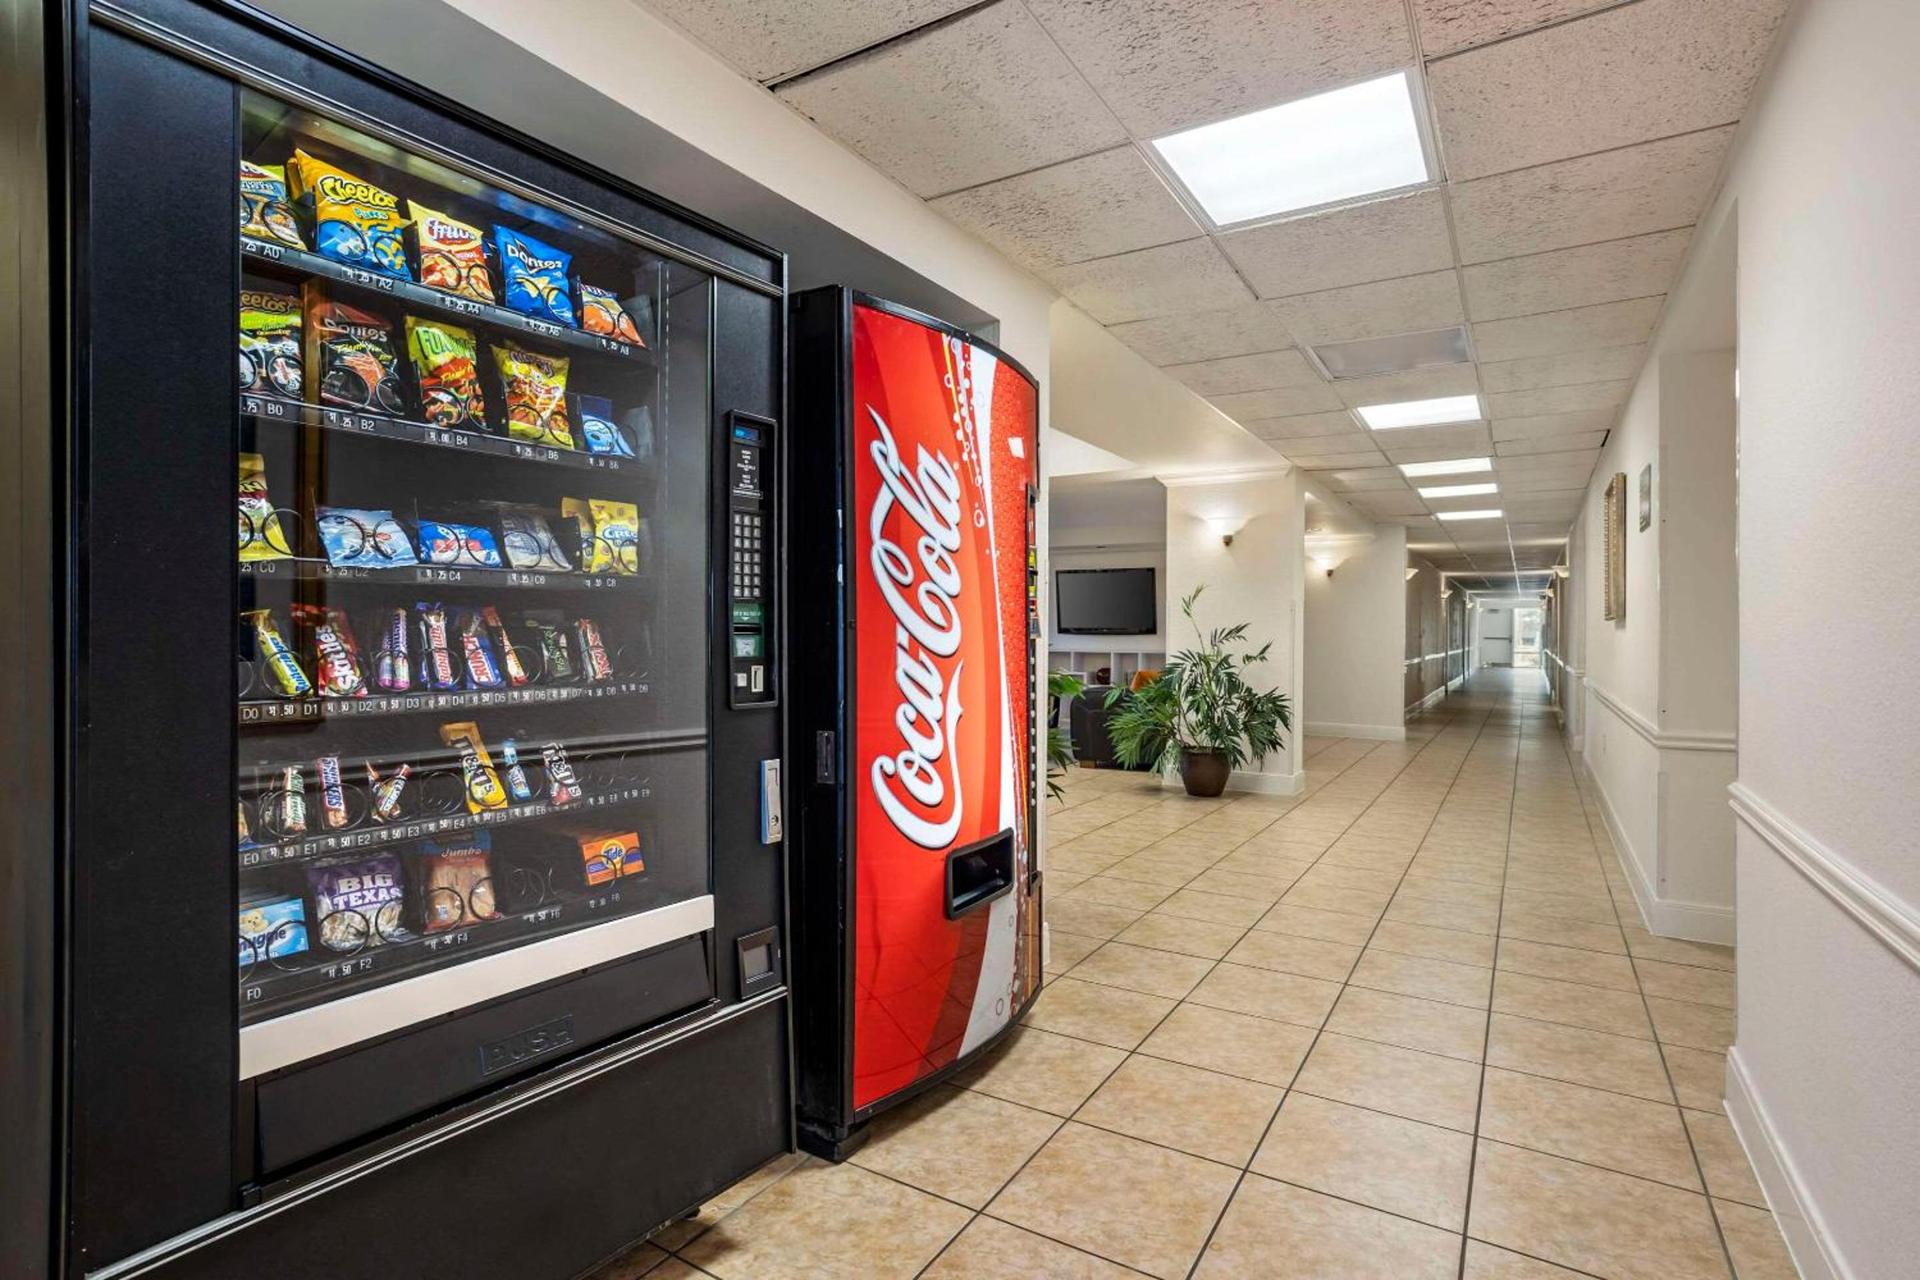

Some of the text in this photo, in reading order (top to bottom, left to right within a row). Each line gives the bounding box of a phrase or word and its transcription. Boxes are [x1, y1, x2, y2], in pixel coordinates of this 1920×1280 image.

[319, 176, 399, 208] Cheetos
[507, 245, 563, 271] Doritos
[240, 292, 288, 312] eetos
[267, 403, 283, 415] B0
[361, 419, 374, 431] B2
[449, 570, 461, 581] C4
[866, 404, 963, 849] Coca-Cola
[316, 625, 358, 690] Skittles
[242, 707, 259, 720] D0
[304, 703, 318, 715] D1
[359, 701, 373, 712] D2
[406, 698, 420, 709] D3
[452, 696, 464, 706] D4
[243, 854, 259, 865] E0
[304, 843, 317, 855] E1
[358, 835, 371, 846] E2
[407, 826, 420, 837] E3
[453, 818, 465, 829] E4
[338, 874, 394, 894] BIG
[333, 888, 404, 910] TEXAS
[457, 933, 468, 944] F4
[360, 958, 372, 970] F2
[247, 988, 262, 1001] F0
